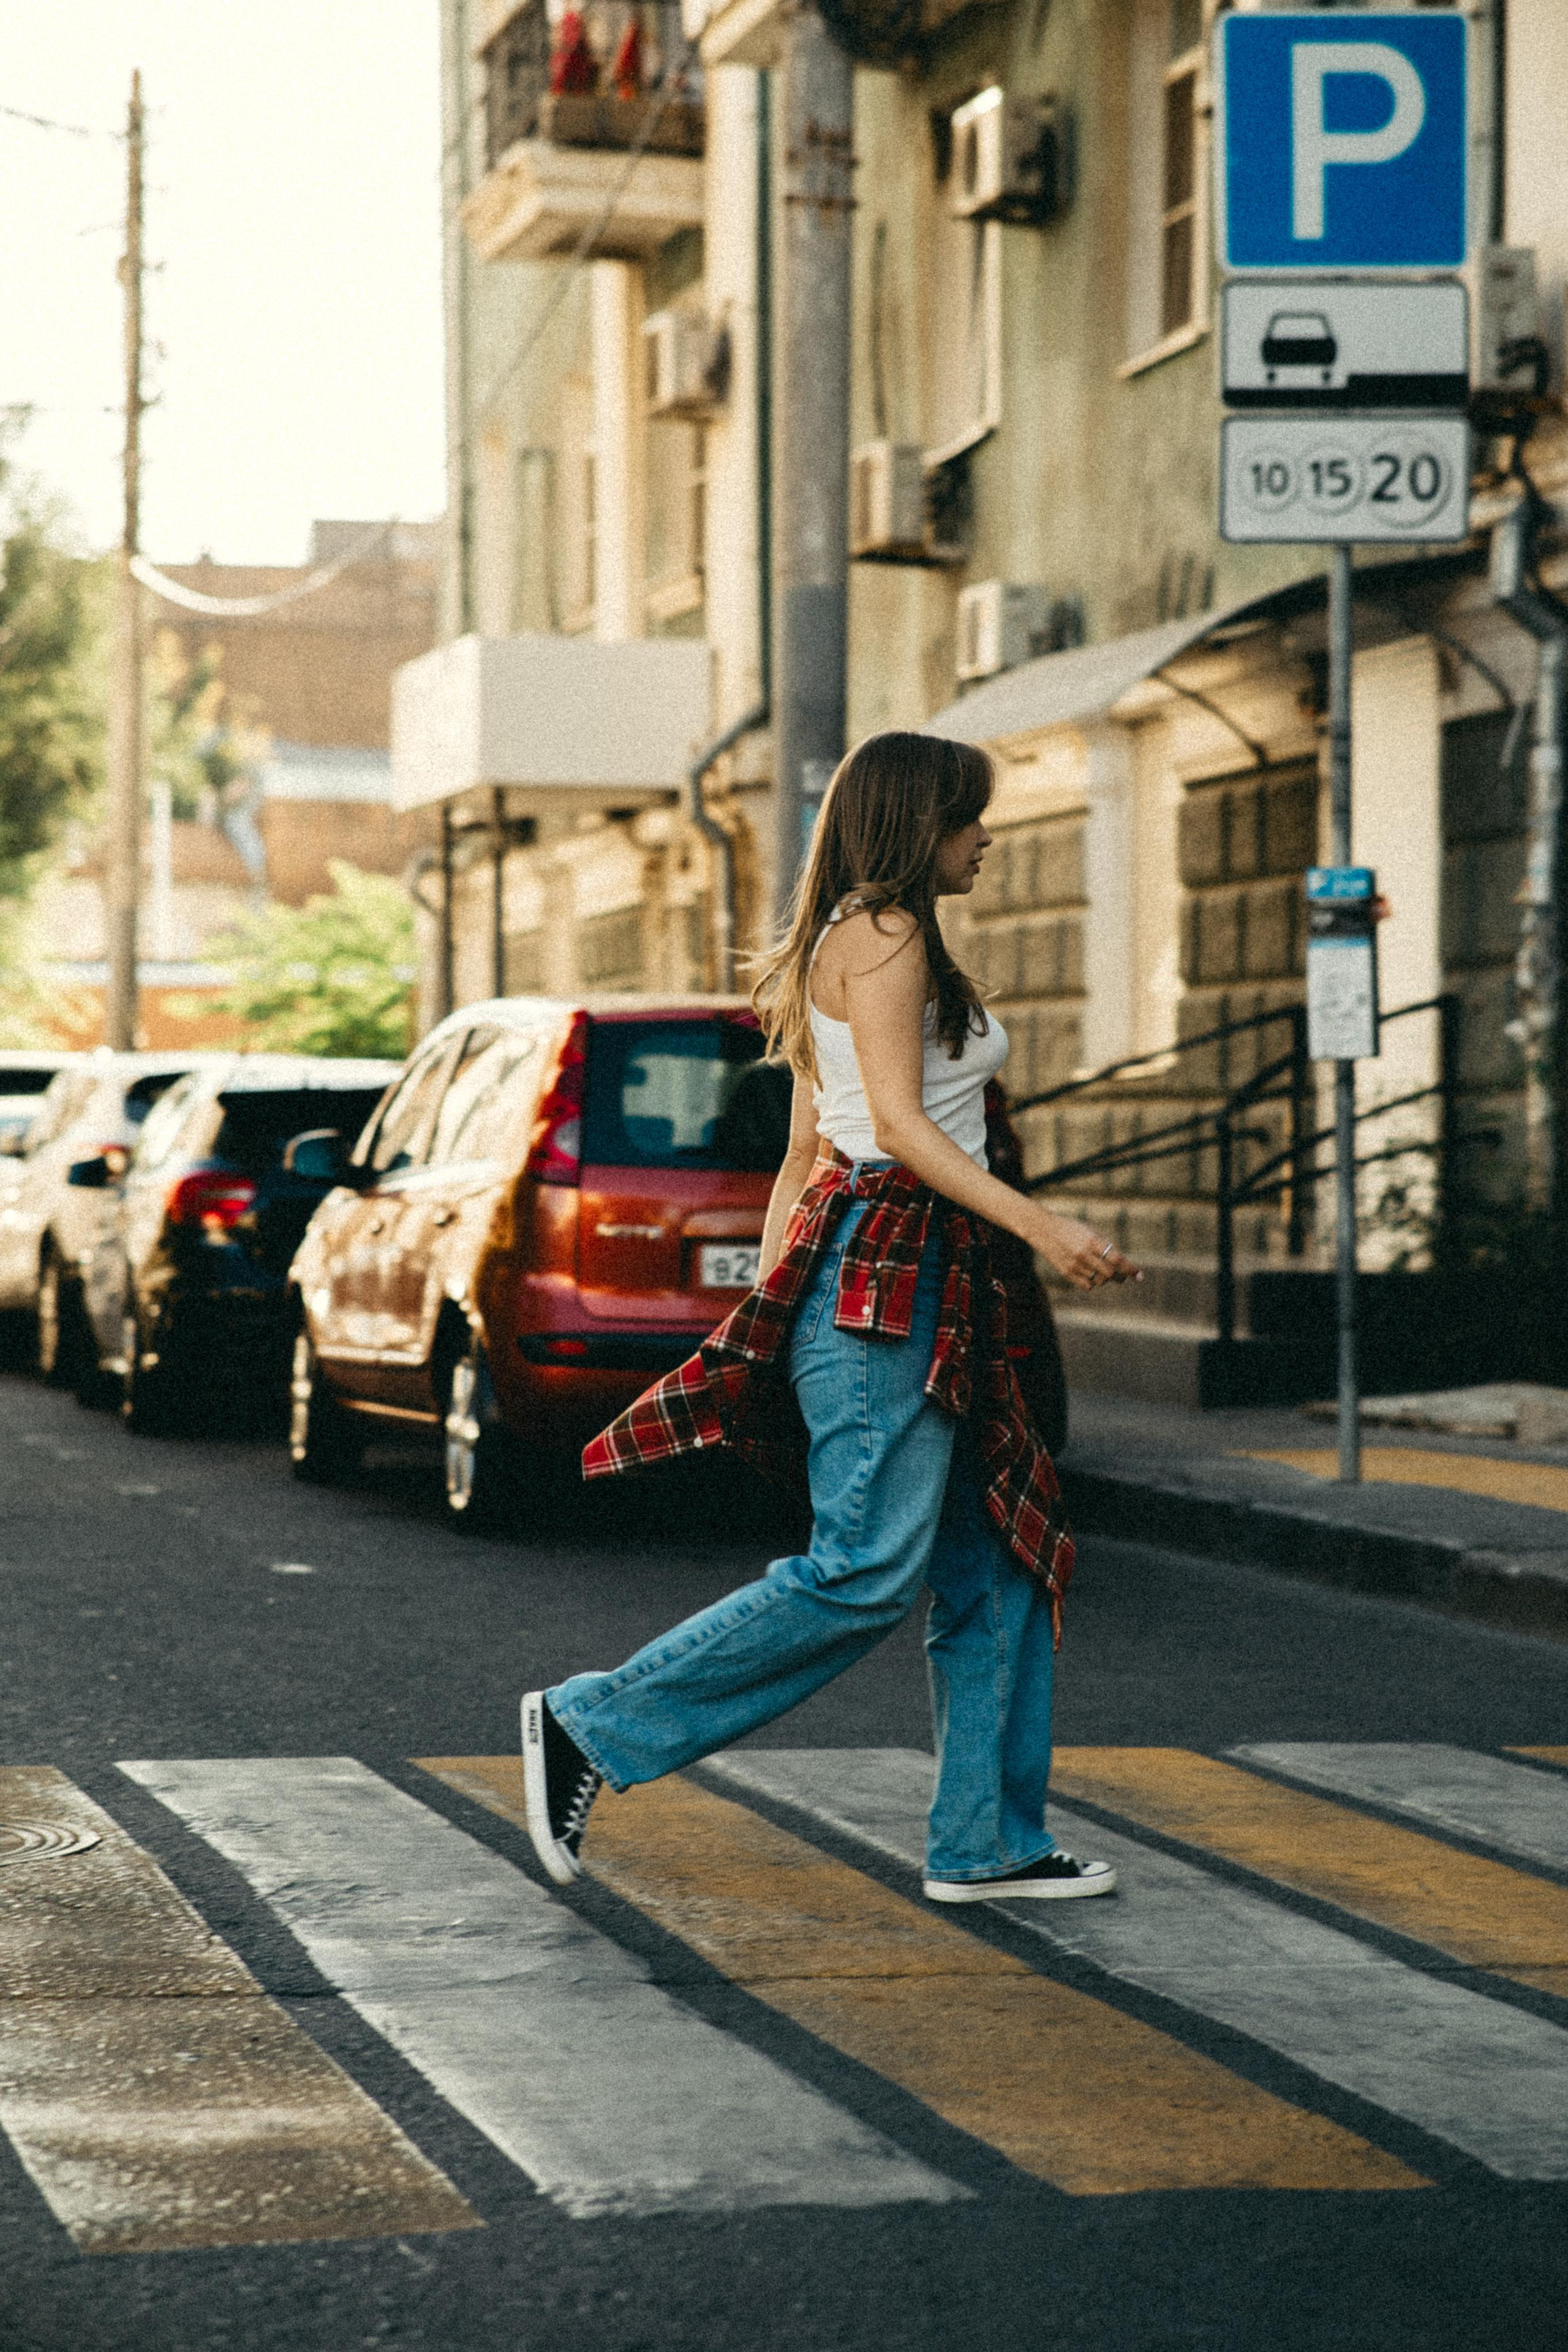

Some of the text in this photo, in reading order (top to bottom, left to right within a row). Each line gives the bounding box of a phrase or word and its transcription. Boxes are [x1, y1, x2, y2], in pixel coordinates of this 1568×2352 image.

[1292, 42, 1426, 240] P
[1251, 453, 1441, 503] 10 15 20
